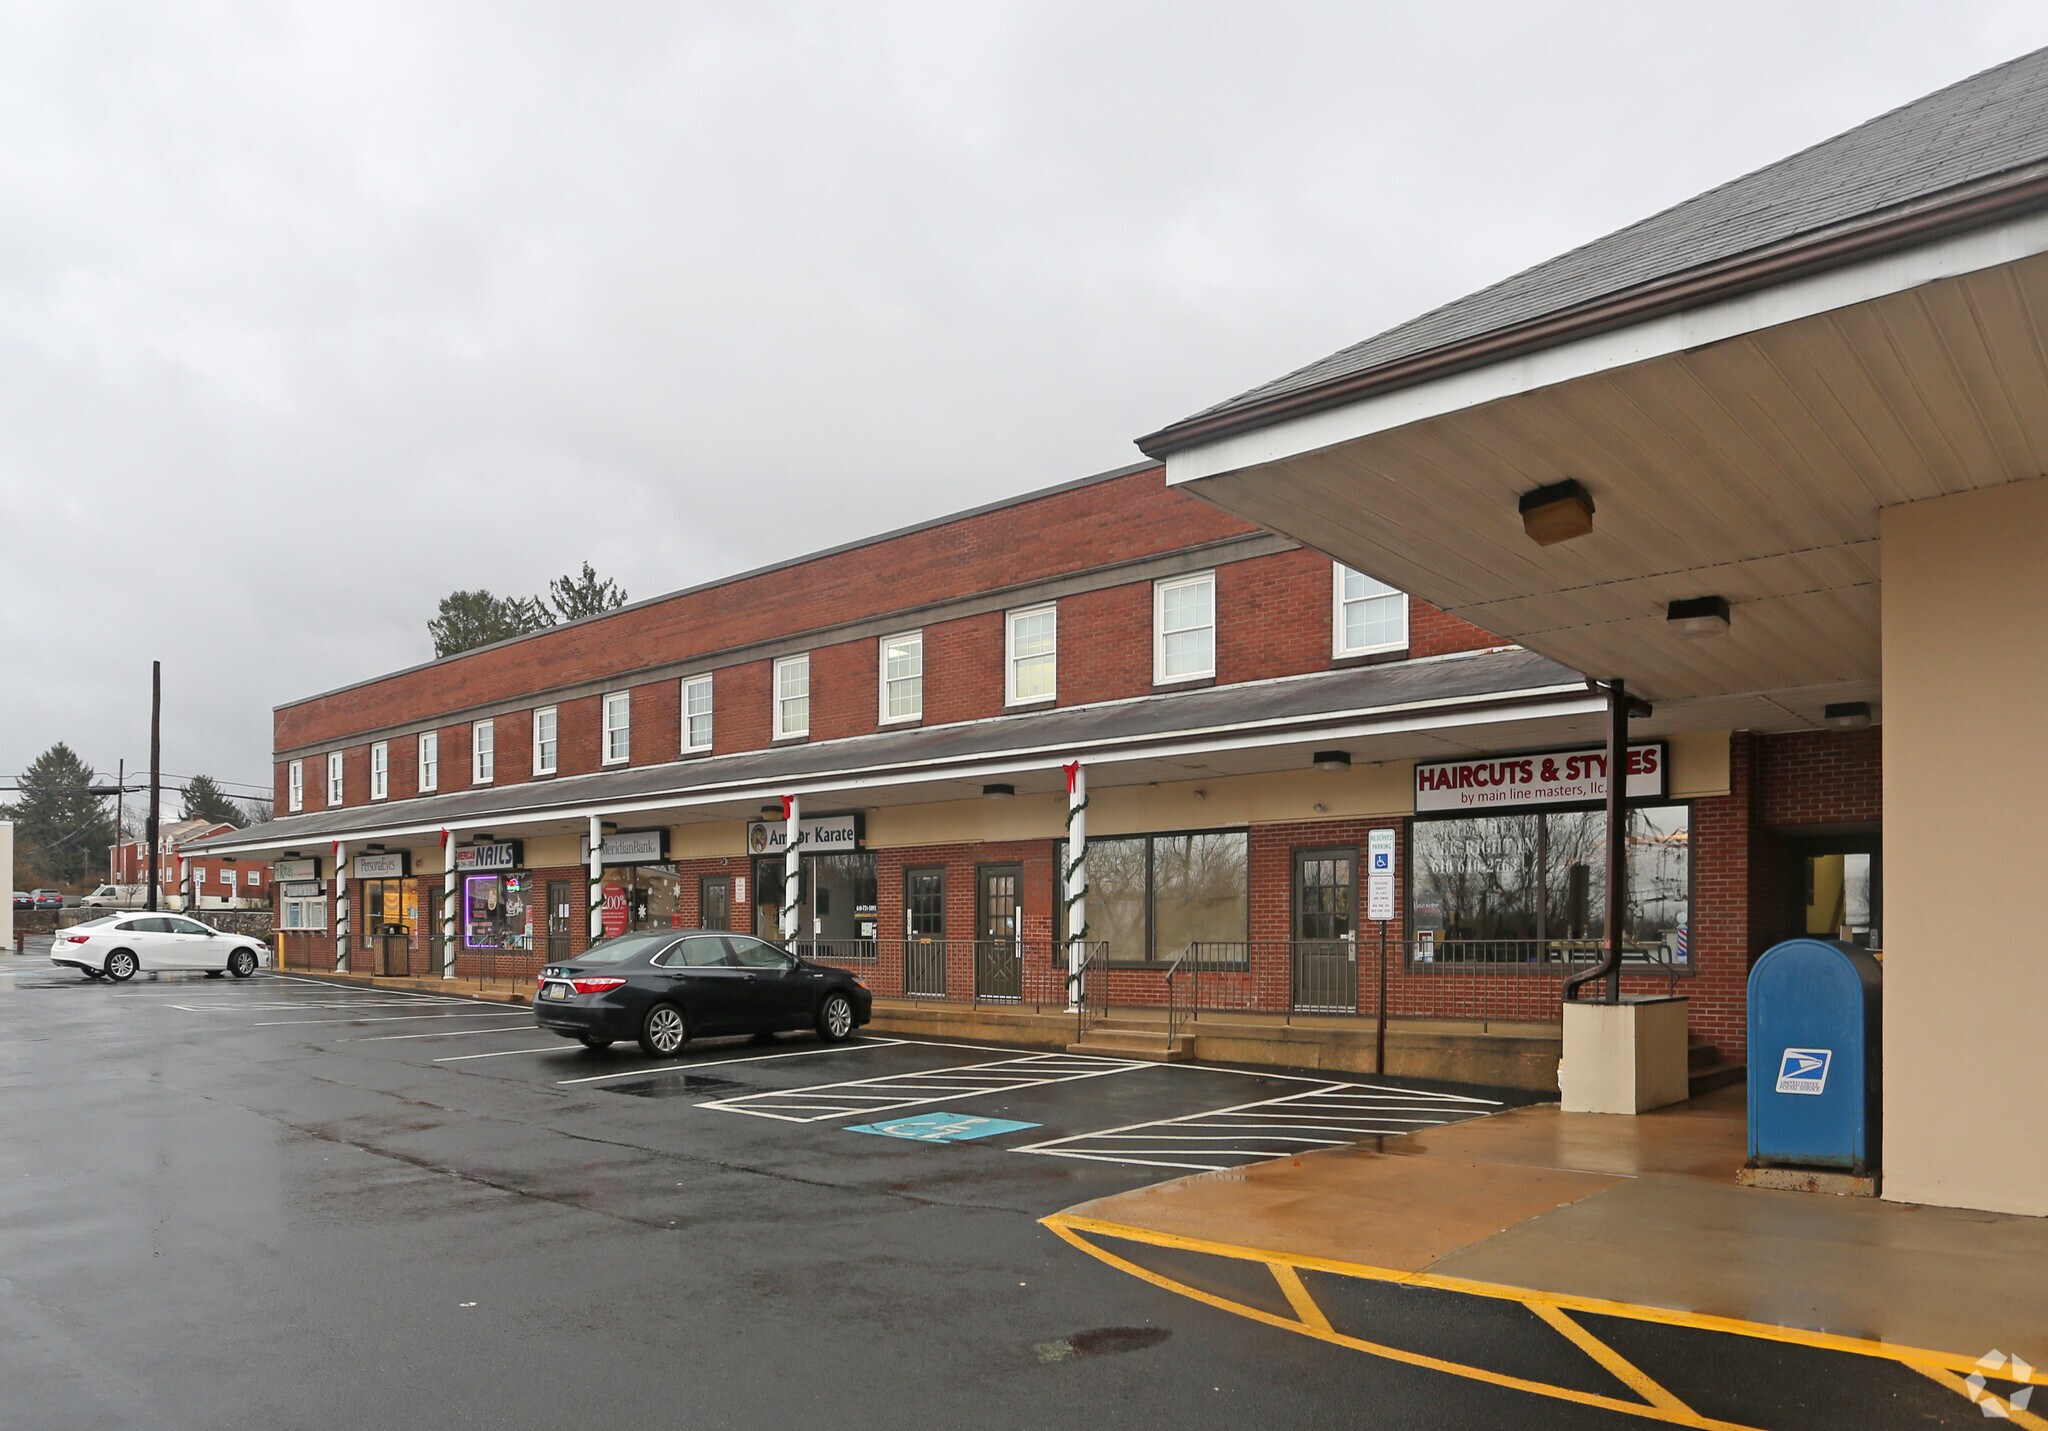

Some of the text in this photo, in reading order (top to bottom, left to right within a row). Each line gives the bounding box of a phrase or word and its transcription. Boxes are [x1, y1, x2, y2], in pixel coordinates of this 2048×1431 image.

[1418, 748, 1658, 792] HAIRCUTS & STYES
[1461, 791, 1475, 806] by
[1477, 791, 1506, 803] main
[1510, 788, 1531, 800] line
[1535, 784, 1587, 799] masters,
[769, 826, 854, 846] Amor Karate
[1370, 833, 1393, 841] RESERVED
[476, 844, 514, 867] NAILS
[1431, 859, 1453, 874] 610
